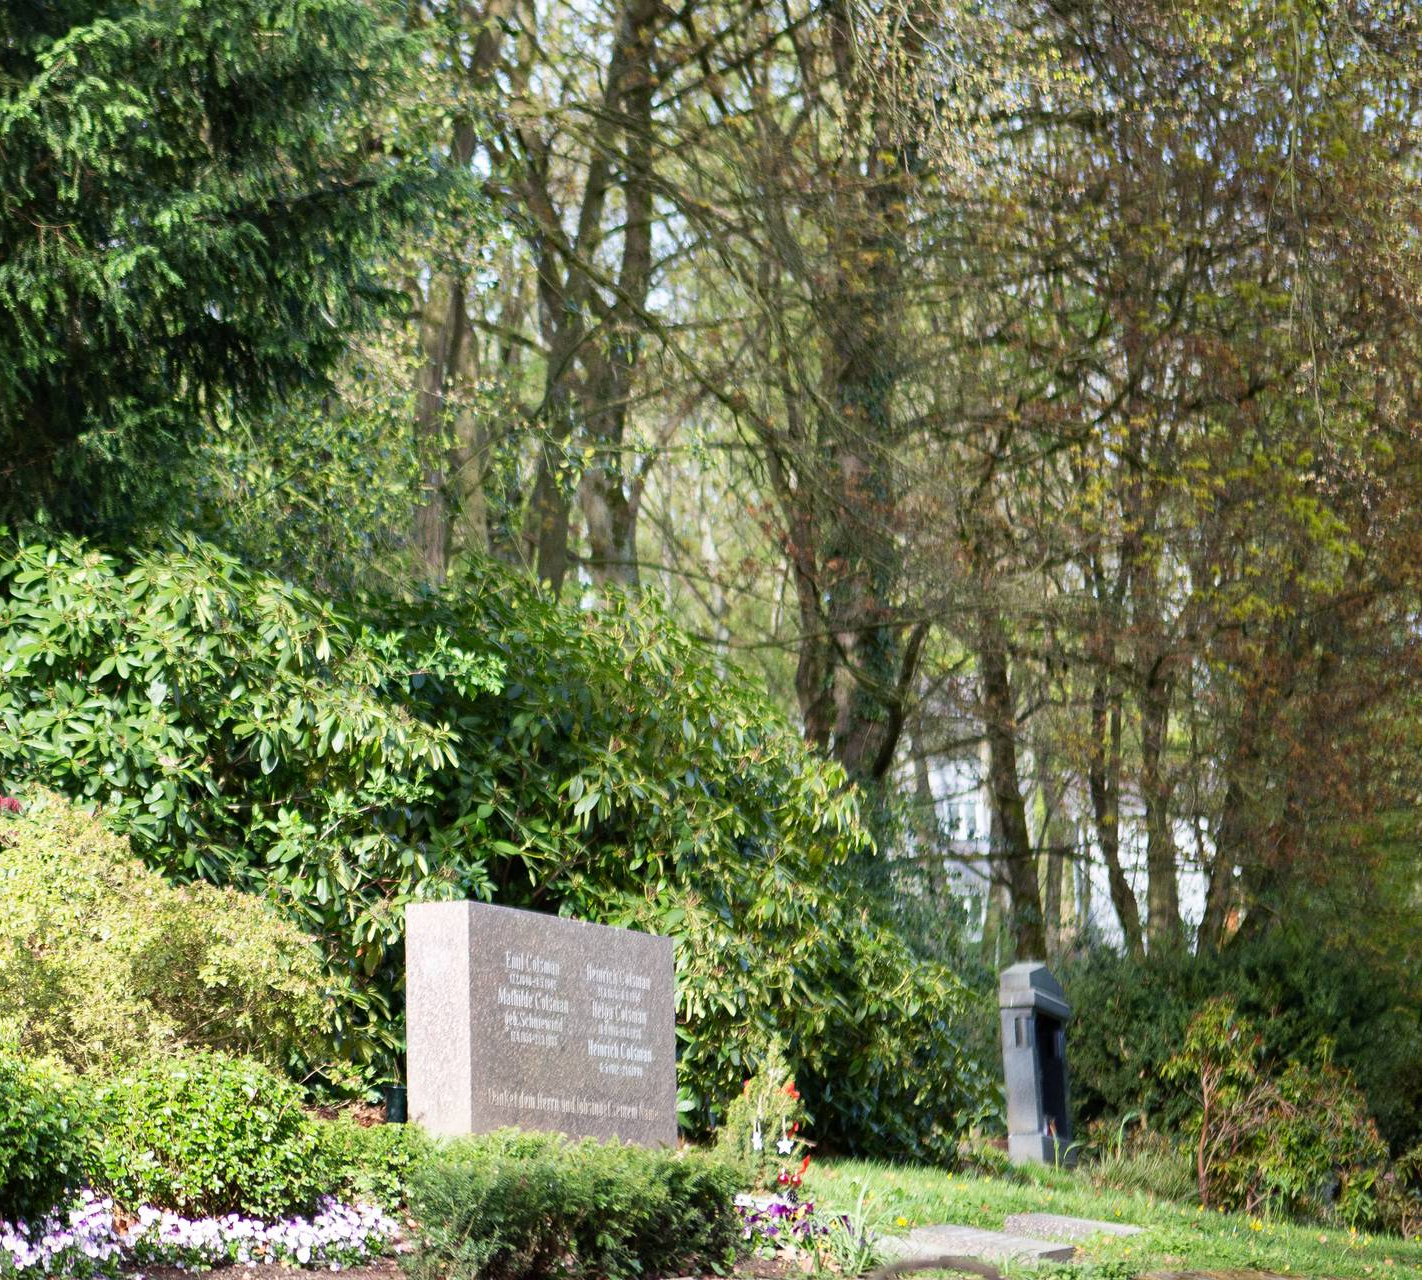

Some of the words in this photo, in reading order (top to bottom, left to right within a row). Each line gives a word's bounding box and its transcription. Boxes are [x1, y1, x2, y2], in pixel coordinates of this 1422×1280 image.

[506, 951, 524, 971] Emil
[586, 963, 618, 985] Heinrich
[498, 986, 532, 1008] Mathilde
[588, 1040, 619, 1059] Heinrich
[519, 1091, 535, 1109] dem
